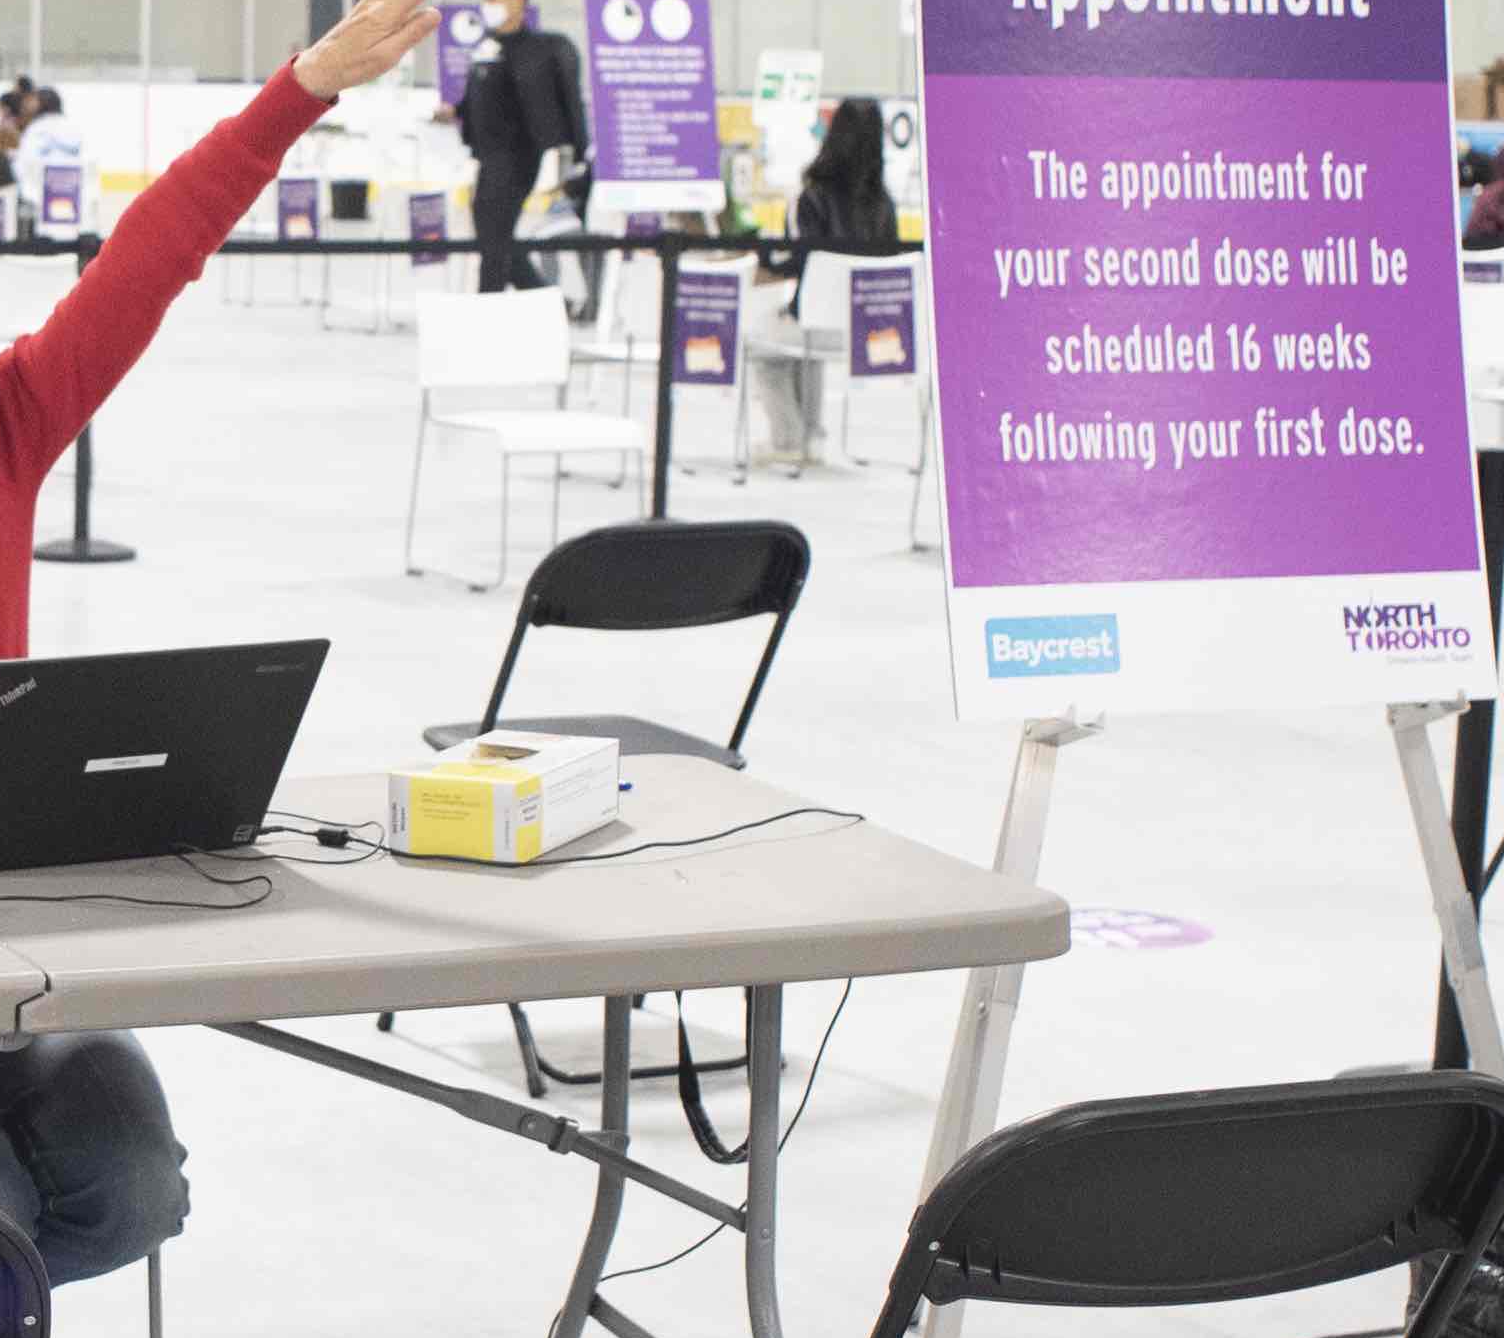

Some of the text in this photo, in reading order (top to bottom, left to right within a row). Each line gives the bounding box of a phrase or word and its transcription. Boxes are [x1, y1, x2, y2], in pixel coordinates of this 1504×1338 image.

[1029, 152, 1367, 210] The appointment for
[996, 238, 1408, 298] your second dose will be
[1047, 324, 1371, 374] scheduled 16 weeks
[1001, 409, 1424, 470] following your first dose.
[1343, 603, 1437, 629] NORTH
[1346, 627, 1472, 652] TORONTO
[991, 628, 1114, 672] Baycrest
